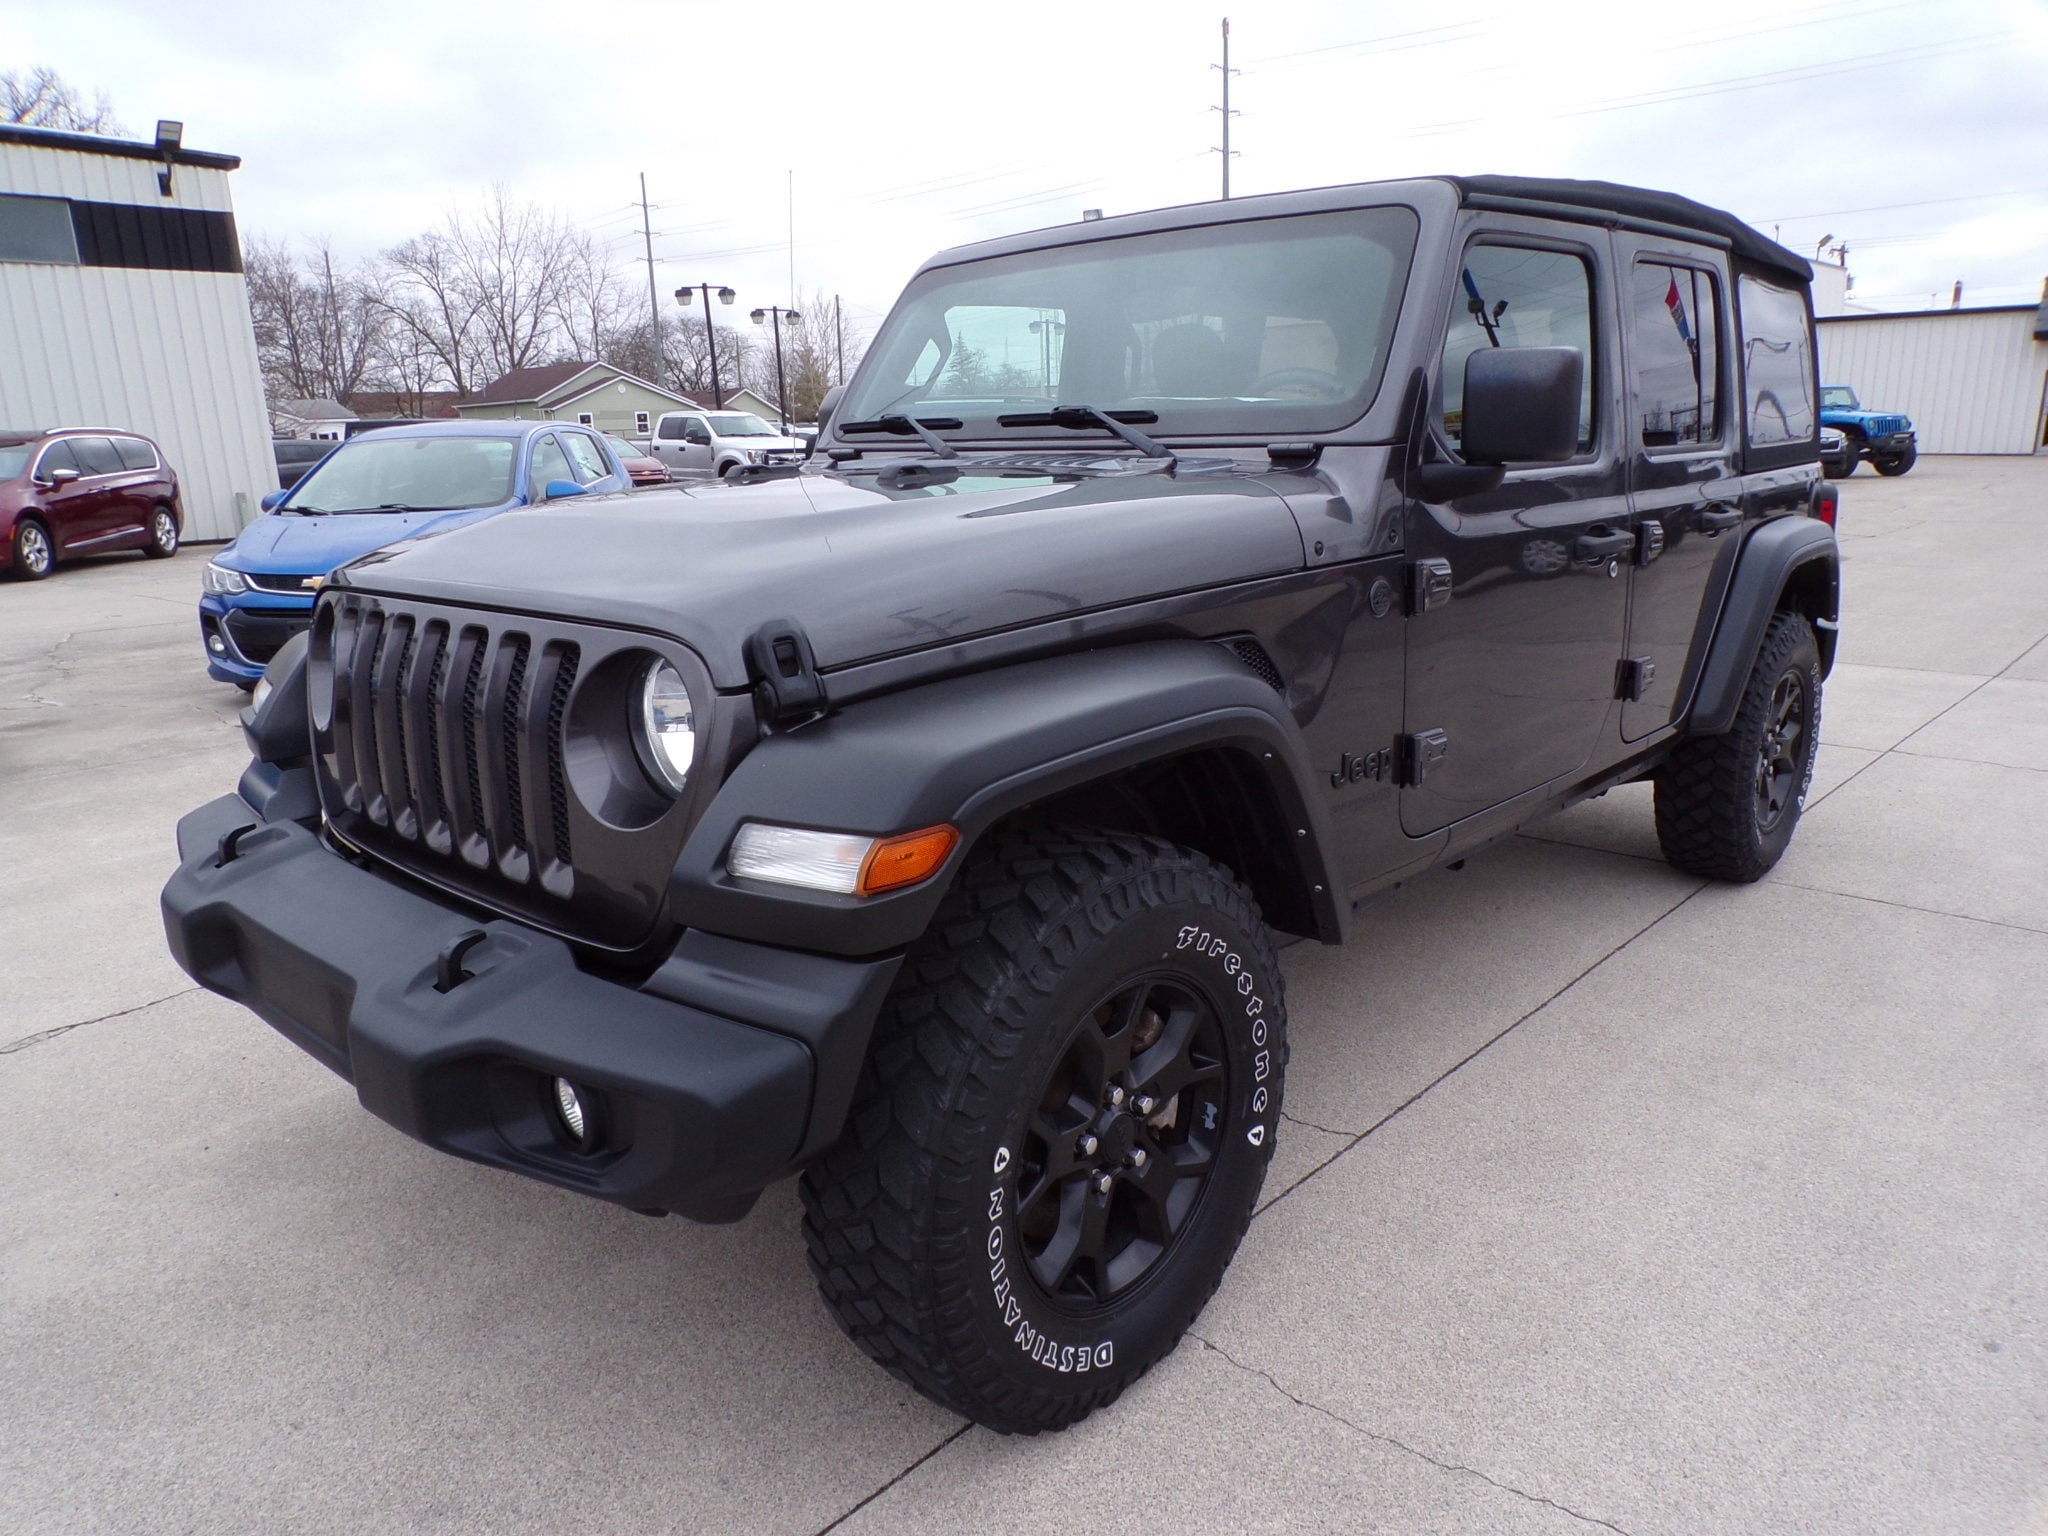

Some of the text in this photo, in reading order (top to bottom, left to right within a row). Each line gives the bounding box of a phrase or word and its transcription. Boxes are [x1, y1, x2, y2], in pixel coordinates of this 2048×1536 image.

[1331, 748, 1391, 789] Jeep
[1176, 926, 1269, 1112] Firestone
[987, 1187, 1114, 1372] DESTINATION
